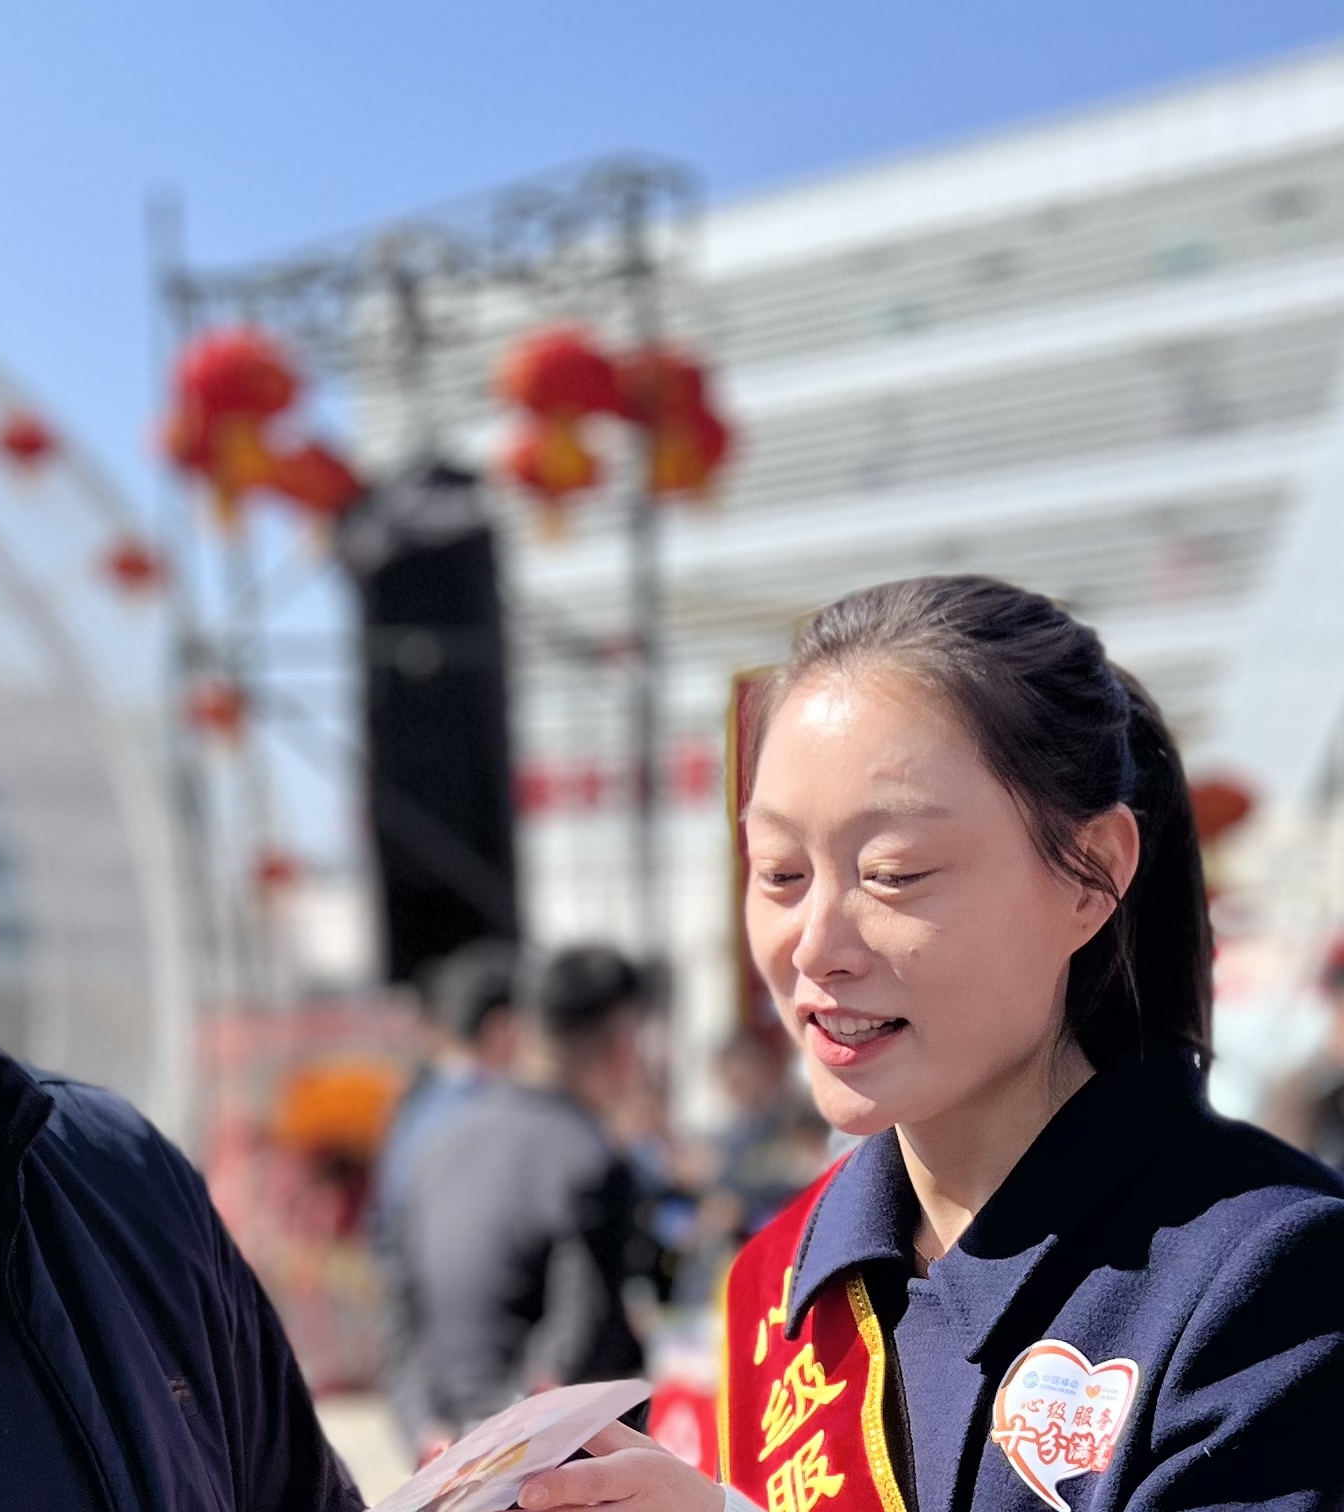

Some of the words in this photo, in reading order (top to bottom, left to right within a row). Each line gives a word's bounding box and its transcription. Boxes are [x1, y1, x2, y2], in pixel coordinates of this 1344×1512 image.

[1019, 1397, 1113, 1431] 心级服务
[991, 1414, 1114, 1472] 十分满意
